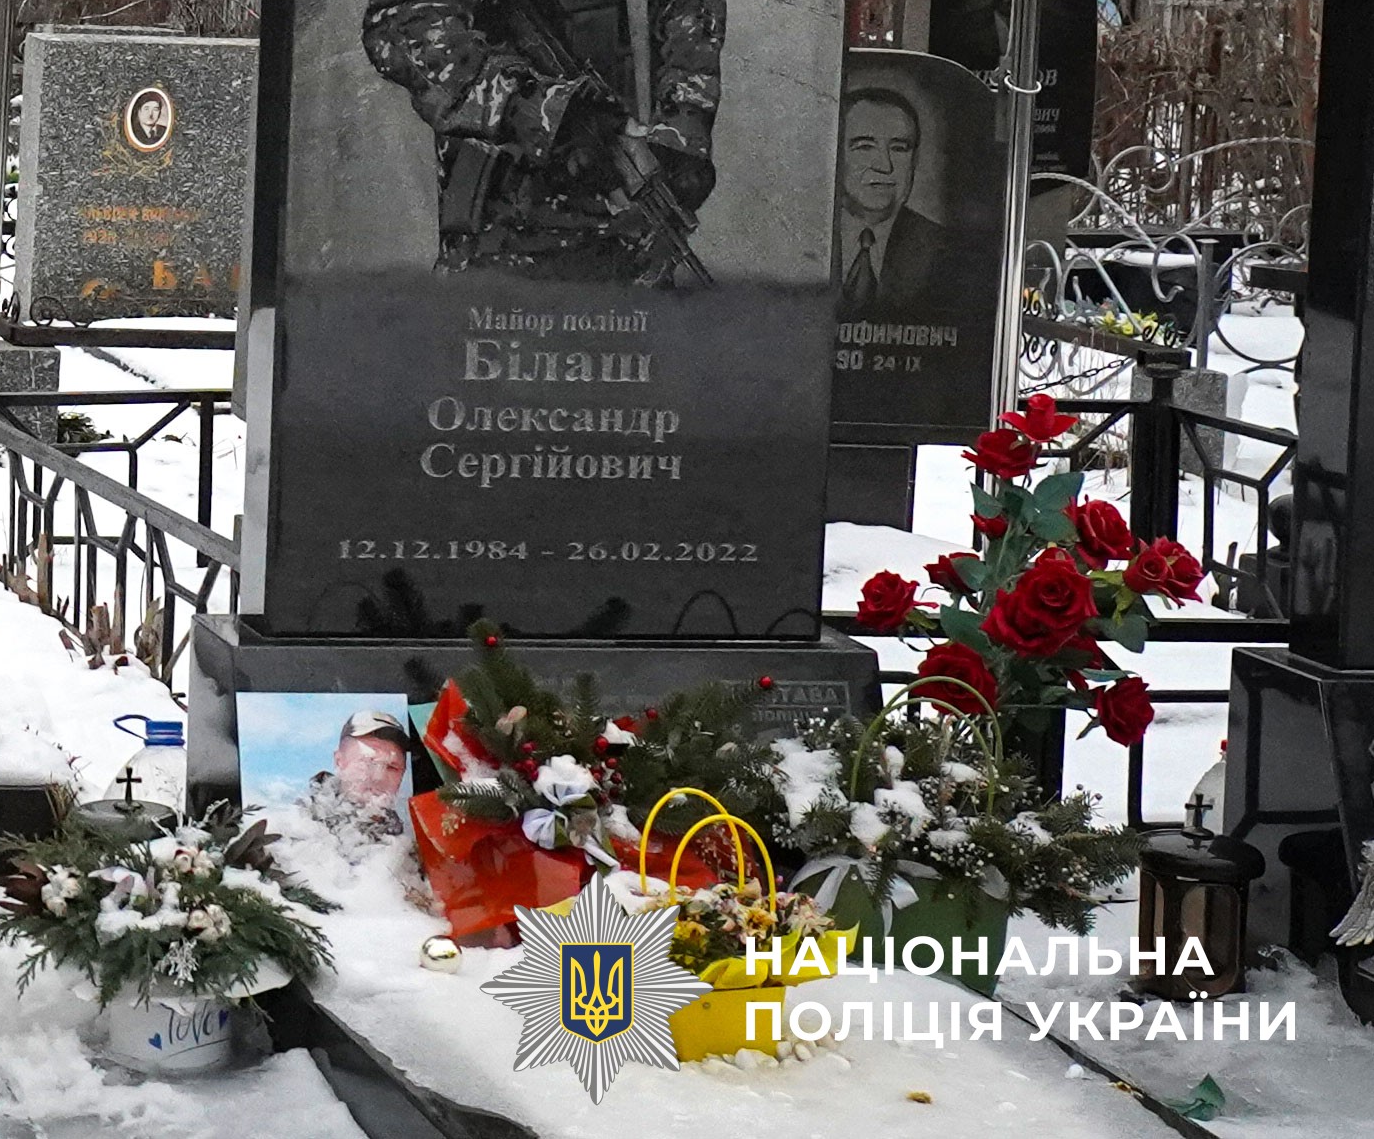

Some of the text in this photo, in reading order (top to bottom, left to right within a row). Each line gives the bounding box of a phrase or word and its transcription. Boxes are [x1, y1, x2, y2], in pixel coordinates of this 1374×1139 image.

[468, 306, 649, 338] Майор поліції
[837, 320, 957, 346] ОФИМОВИЧ
[462, 339, 652, 383] Білаш
[427, 395, 681, 443] Олександр
[420, 443, 682, 487] Сергійович
[339, 540, 528, 560] 12.12.1984
[567, 541, 758, 562] 26.02.2022
